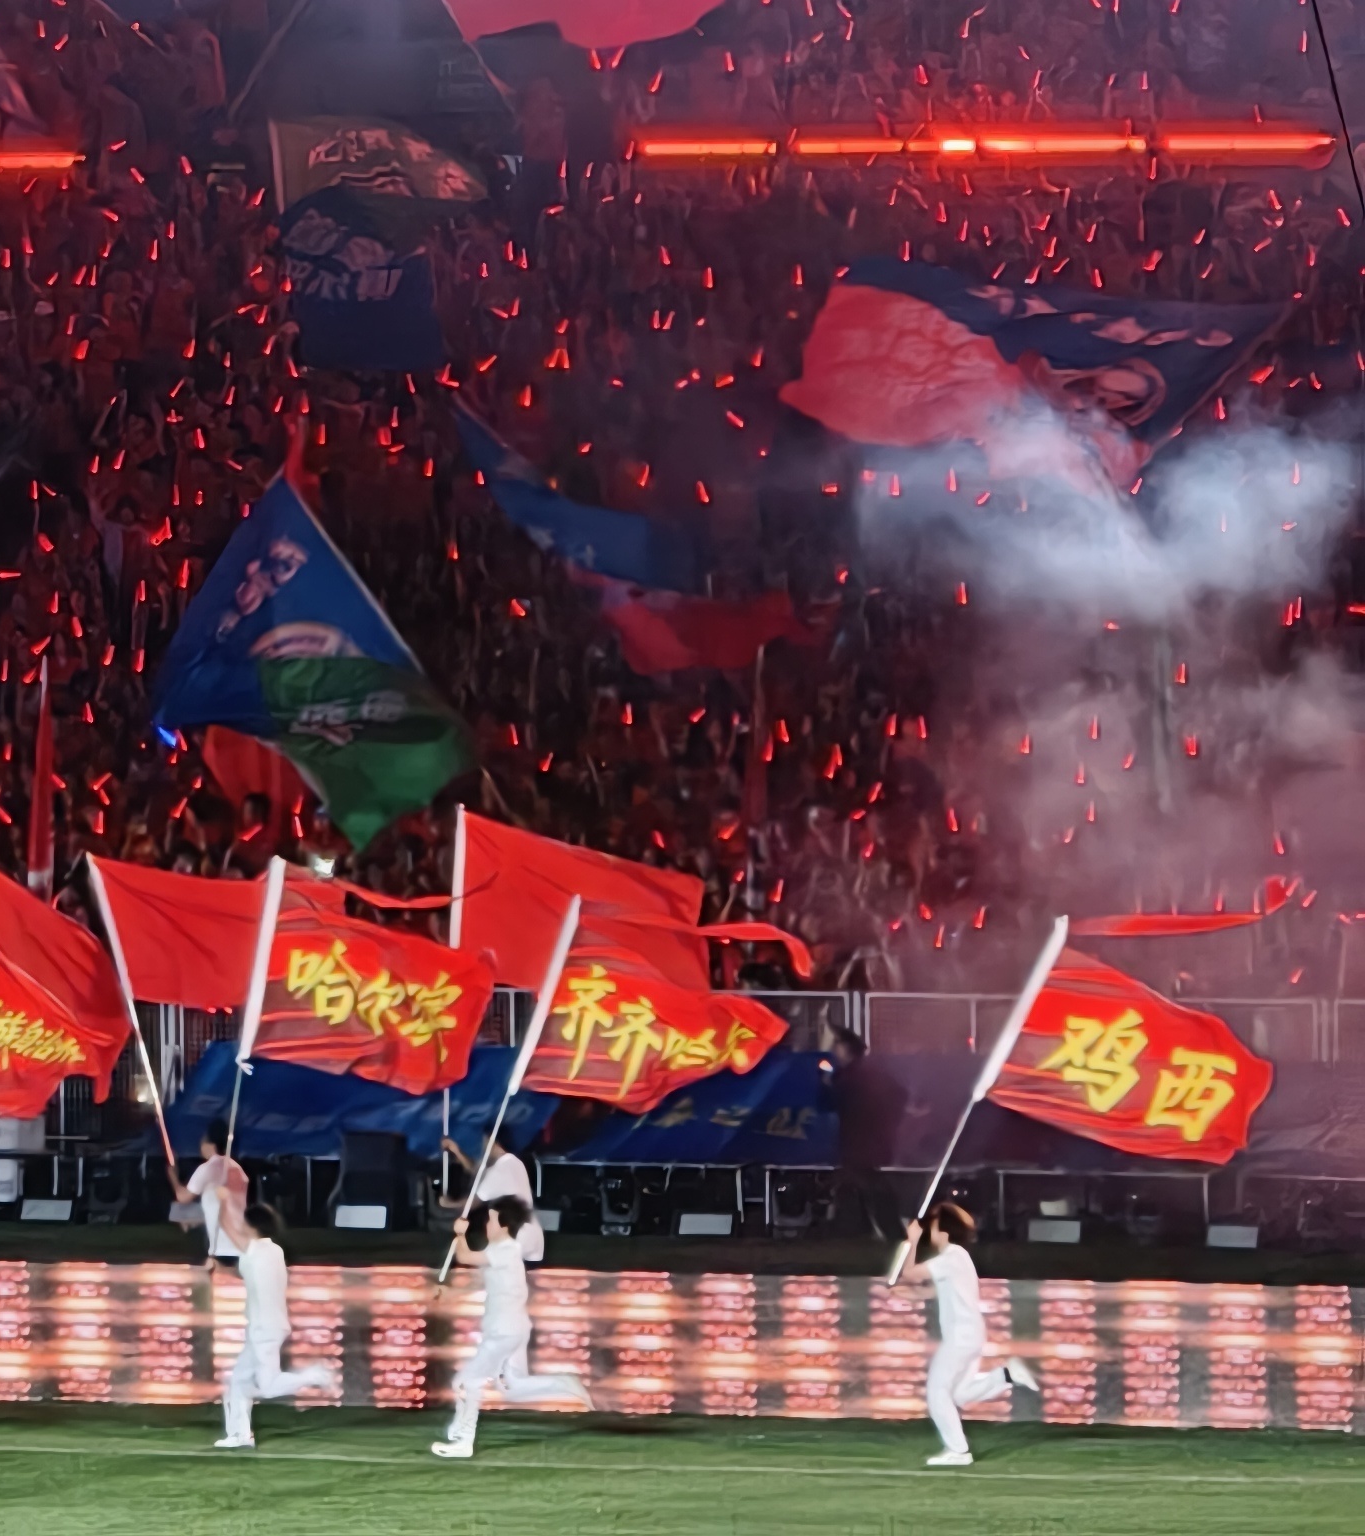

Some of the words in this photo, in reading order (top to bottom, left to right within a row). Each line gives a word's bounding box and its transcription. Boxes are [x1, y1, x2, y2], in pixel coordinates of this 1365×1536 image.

[287, 939, 464, 1062] 哈尔滨
[553, 964, 756, 1100] 齐齐哈尔
[1036, 1008, 1237, 1142] 鸡西
